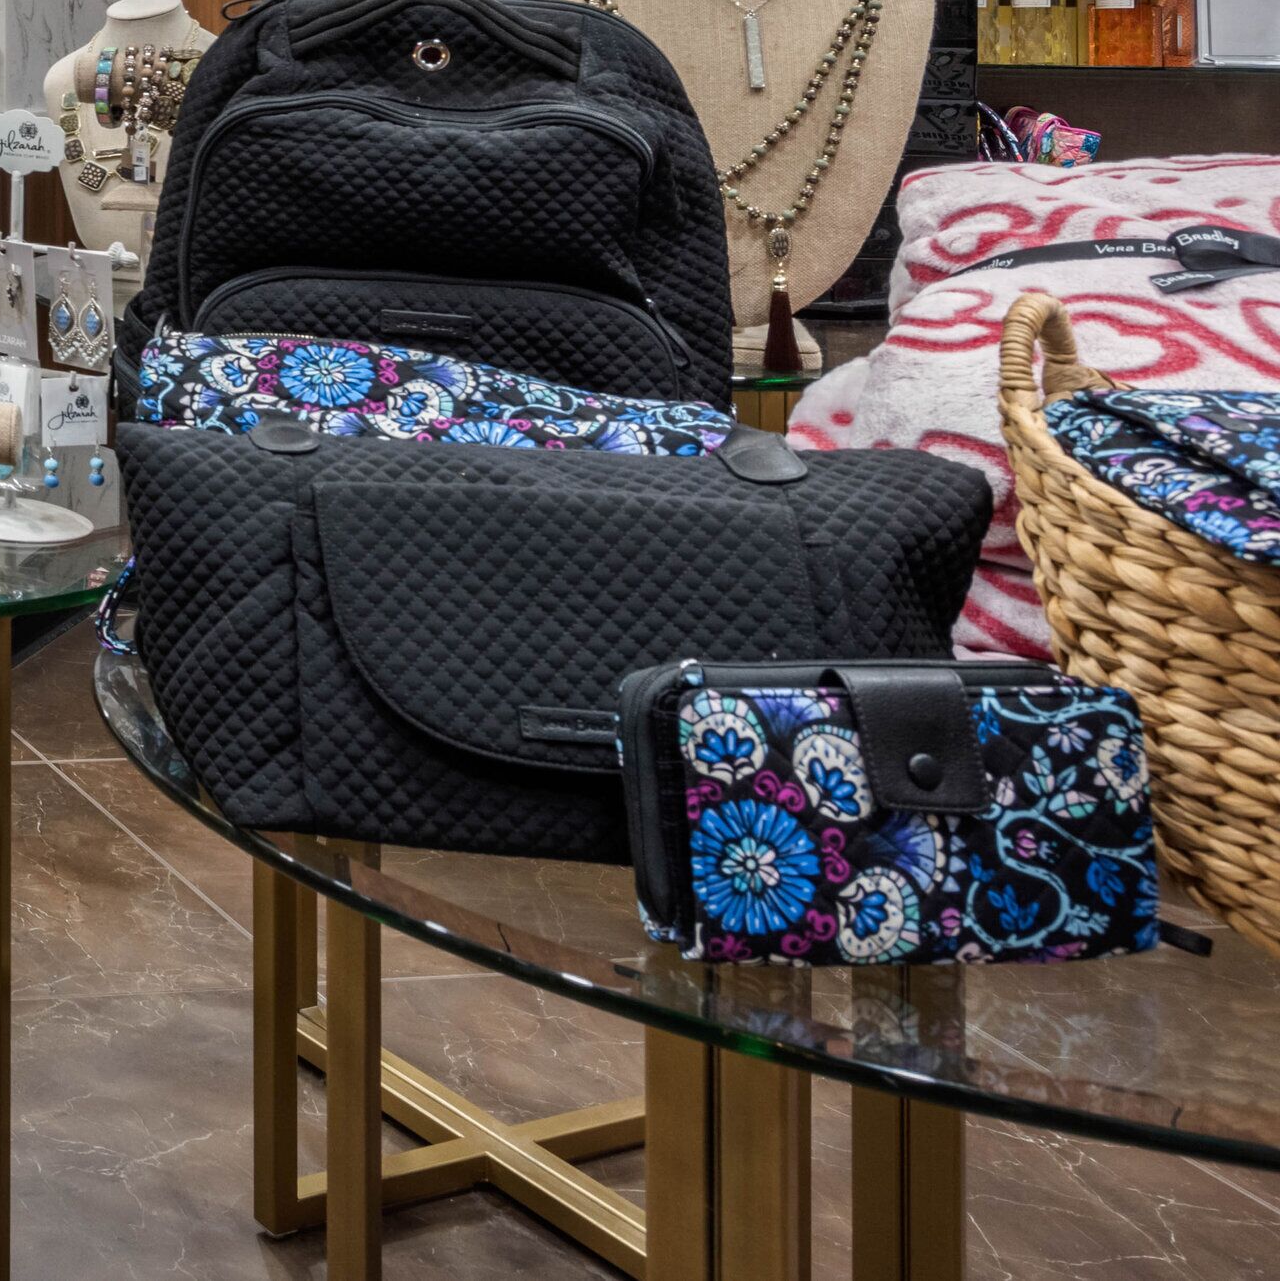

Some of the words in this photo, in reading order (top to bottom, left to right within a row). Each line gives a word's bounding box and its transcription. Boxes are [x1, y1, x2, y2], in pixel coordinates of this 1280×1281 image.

[1176, 230, 1241, 251] Bradley
[1094, 243, 1136, 256] Vera
[1152, 272, 1215, 289] Bradley
